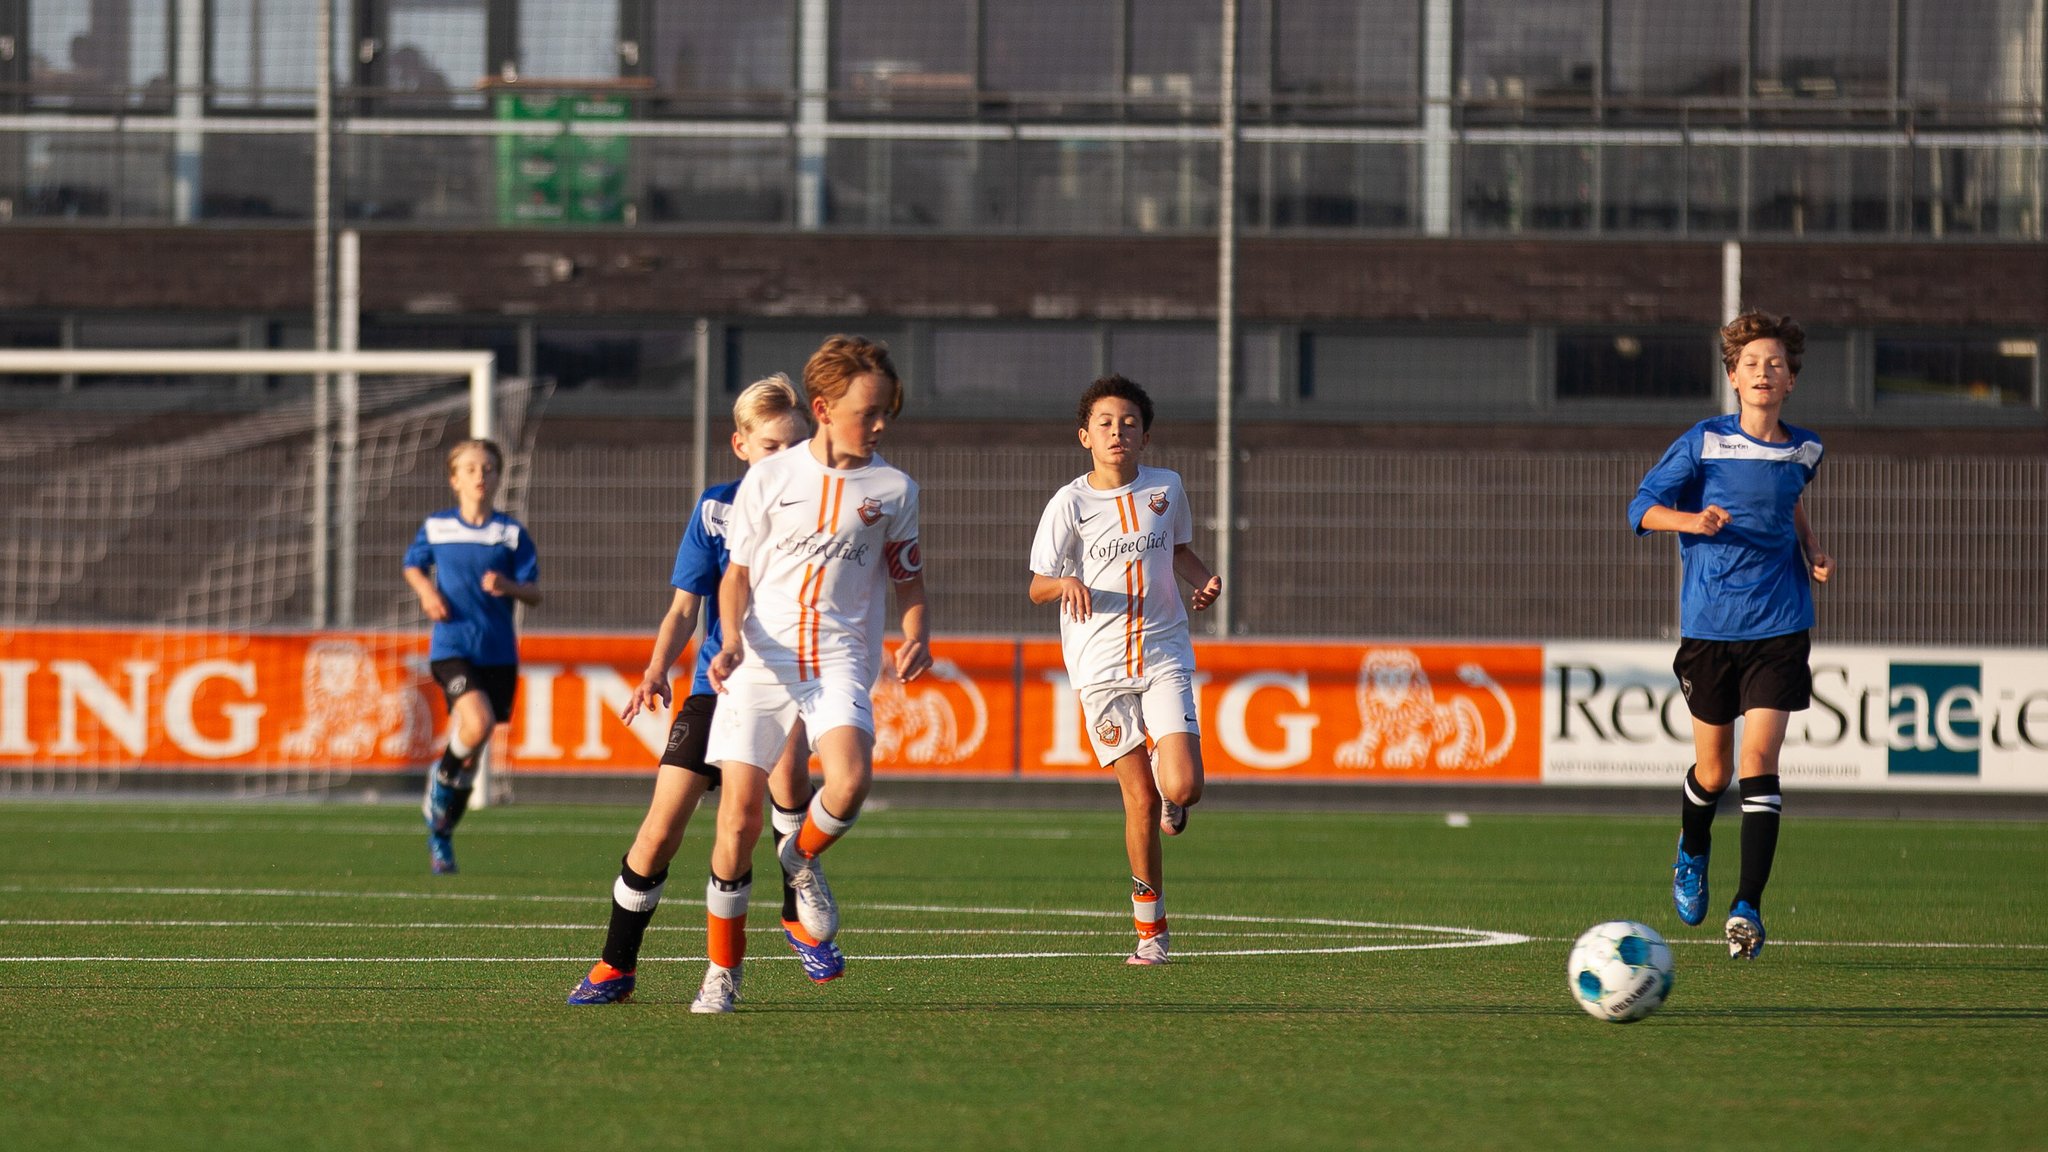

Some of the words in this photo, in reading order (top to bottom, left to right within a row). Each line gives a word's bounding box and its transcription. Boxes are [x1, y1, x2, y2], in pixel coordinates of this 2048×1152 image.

[900, 540, 923, 572] C
[1089, 530, 1168, 562] CoffeeClick
[0, 658, 267, 759] ING
[516, 664, 682, 760] IN
[1041, 669, 1320, 769] IG
